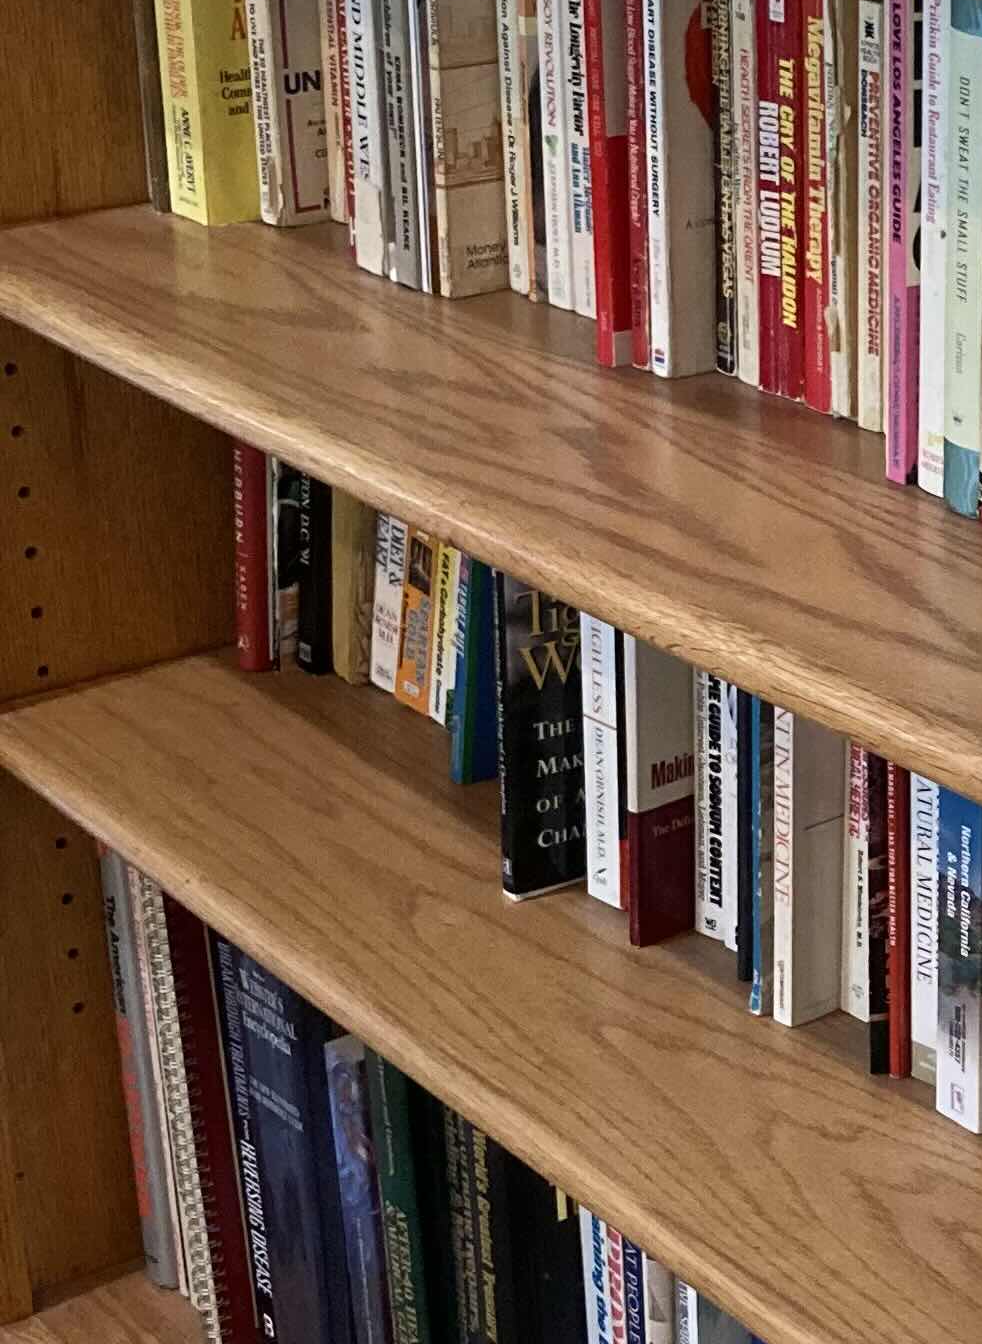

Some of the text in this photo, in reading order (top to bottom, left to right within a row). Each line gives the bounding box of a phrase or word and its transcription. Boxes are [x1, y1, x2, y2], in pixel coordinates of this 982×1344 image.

[382, 0, 394, 48] children
[501, 23, 513, 74] Against
[567, 21, 585, 89] Longevity
[647, 29, 658, 86] DISEASE
[329, 55, 340, 106] VITAMIN
[351, 32, 370, 130] MIDDLE
[504, 76, 514, 125] Disease
[544, 30, 558, 127] REVOLUTION
[860, 68, 869, 138] DONSBACH
[928, 52, 942, 91] Guide
[570, 90, 587, 137] Factor
[649, 90, 660, 151] WITHOUT
[892, 2, 903, 245] LOVE LOS ANGELES GUIDE
[927, 110, 941, 181] Restaurant
[394, 55, 412, 251] ERMA BOMBECK KEANE
[739, 48, 756, 284] HEALTH SECRETS ORIENT
[804, 16, 826, 284] Megavitamin Therapy
[651, 155, 661, 217] SURGERY
[758, 100, 782, 277] ROBERT LUDLUM
[778, 58, 799, 329] THE CRY OF THE HALIDON
[867, 71, 881, 358] PREVENTIVE ORGANIC MEDICINE
[926, 183, 942, 225] Eating
[955, 75, 971, 304] DON'T SWEAT THE SMALL STUFF
[511, 199, 521, 247] Williams
[722, 245, 735, 299] VEGAS
[389, 523, 407, 567] DIET
[436, 552, 451, 676] FAT Carbohydrate
[591, 669, 604, 714] LESS
[532, 719, 575, 741] THE
[593, 726, 604, 767] DEAN
[708, 702, 726, 908] GUIDE TO SODIUM CONTENT
[774, 742, 791, 908] IN MEDICINE
[104, 895, 120, 929] The
[946, 865, 959, 918] Nevada
[959, 824, 974, 958] Northern California
[916, 873, 935, 984] MEDICINE
[240, 1139, 274, 1298] REVERSING DISEASE
[393, 1208, 415, 1299] AFTER-40
[595, 1294, 612, 1331] the
[626, 1269, 644, 1339] PEOPLE
